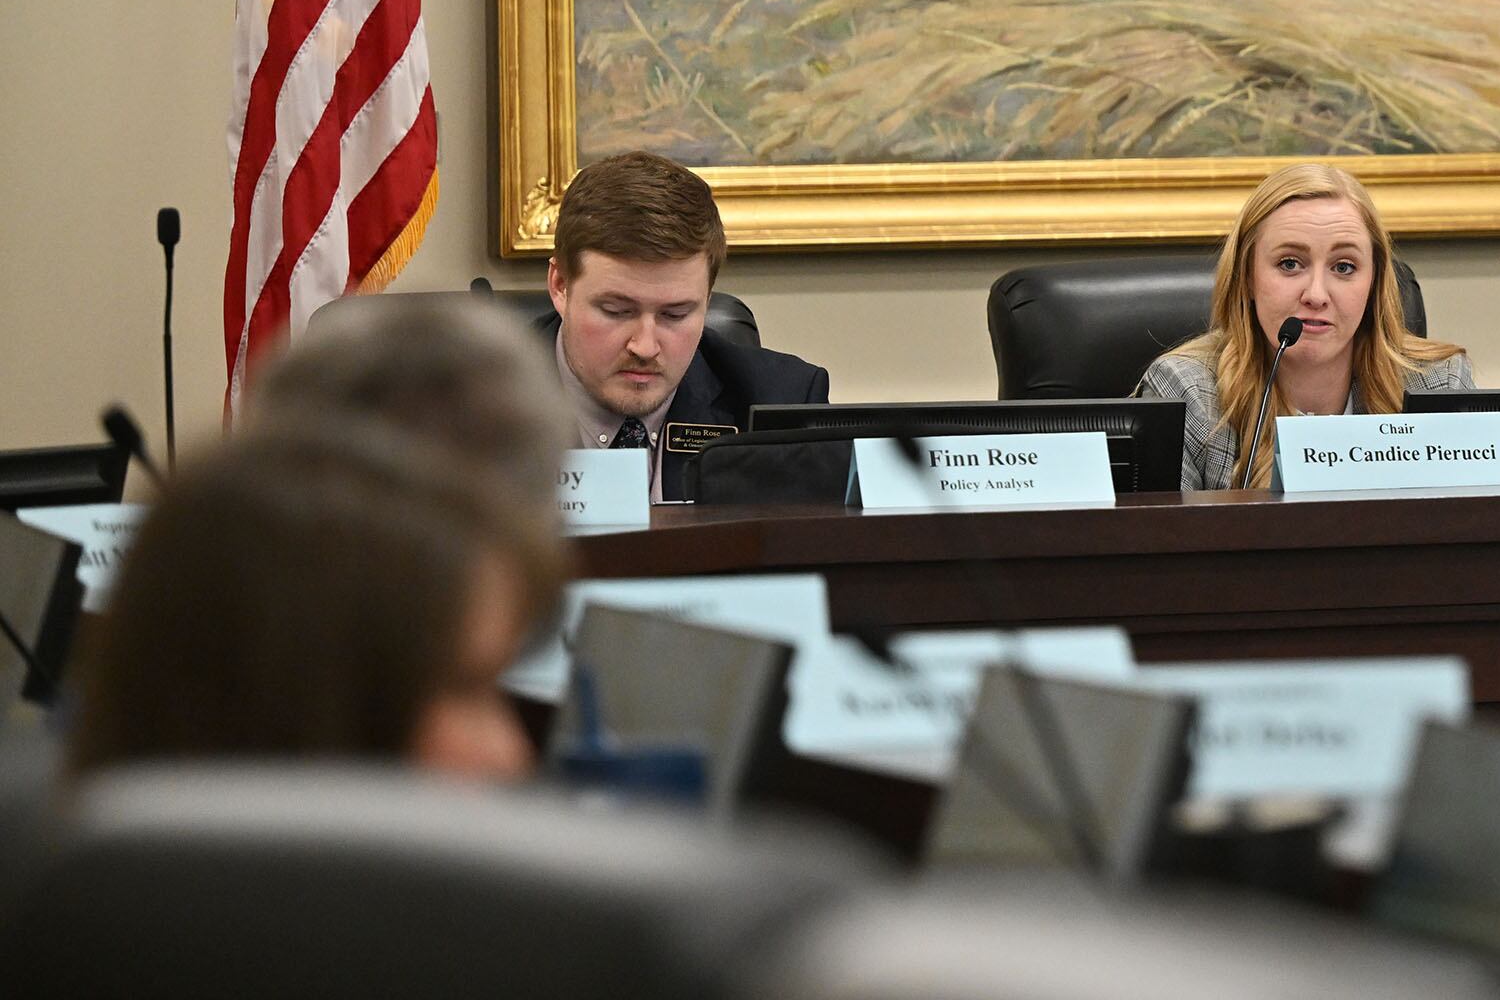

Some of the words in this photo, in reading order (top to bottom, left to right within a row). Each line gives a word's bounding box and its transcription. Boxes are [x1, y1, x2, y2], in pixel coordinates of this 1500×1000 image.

[685, 428, 702, 436] Finn
[703, 429, 721, 437] Rose
[1379, 423, 1415, 435] Chair
[928, 449, 980, 468] Finn
[986, 448, 1039, 467] Rose
[1303, 447, 1343, 467] Rep.
[1349, 445, 1420, 463] Candice
[1426, 444, 1497, 461] Pierucci
[940, 479, 980, 493] Policy
[985, 477, 1035, 492] Analyst
